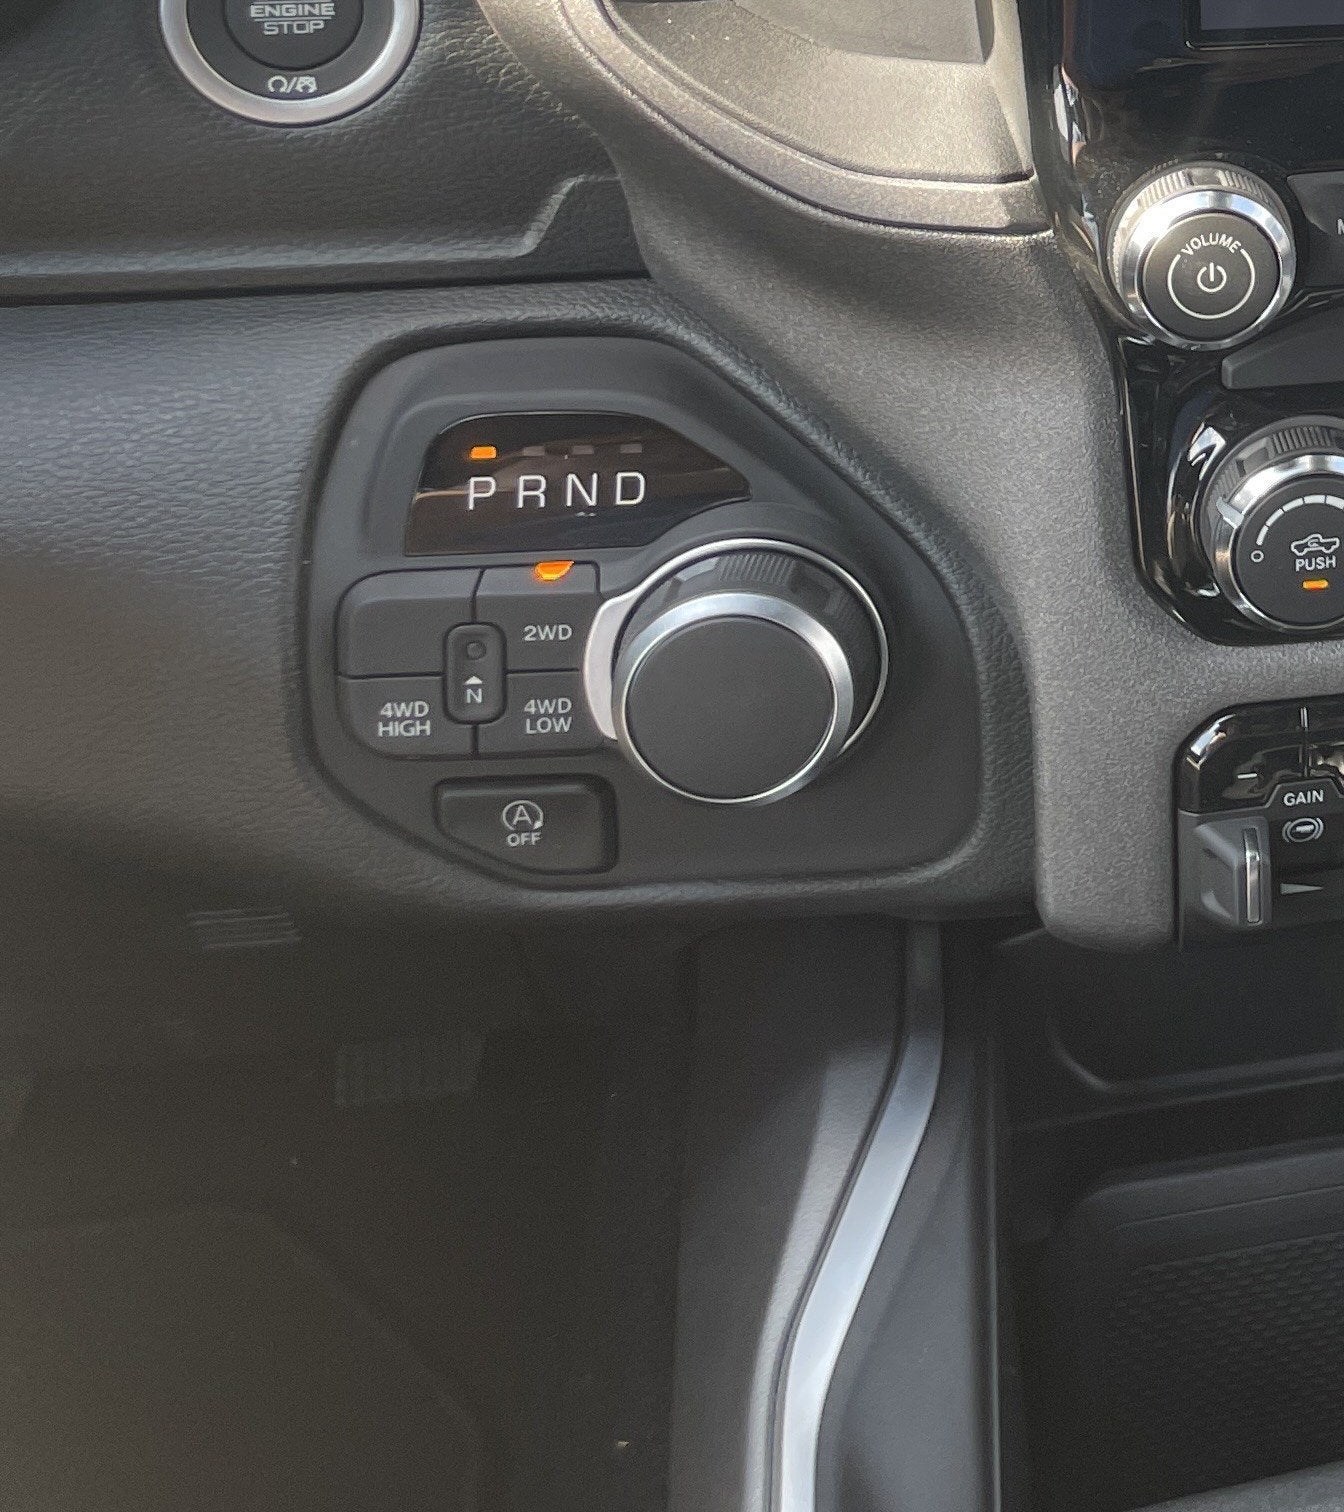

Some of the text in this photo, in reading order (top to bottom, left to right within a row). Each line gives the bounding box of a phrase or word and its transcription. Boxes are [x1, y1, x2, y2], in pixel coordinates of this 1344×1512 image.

[250, 3, 336, 18] ENGINE
[263, 19, 325, 35] STOP
[1181, 232, 1242, 256] VOLUME
[1294, 554, 1337, 572] PUSH
[523, 623, 573, 642] 2WD
[465, 687, 482, 705] N
[380, 700, 429, 719] 4WD
[523, 698, 572, 716] 4WD
[378, 720, 431, 738] HIGH
[525, 717, 573, 734] LOW
[1283, 789, 1324, 807] GAIN
[506, 832, 541, 847] OFF
